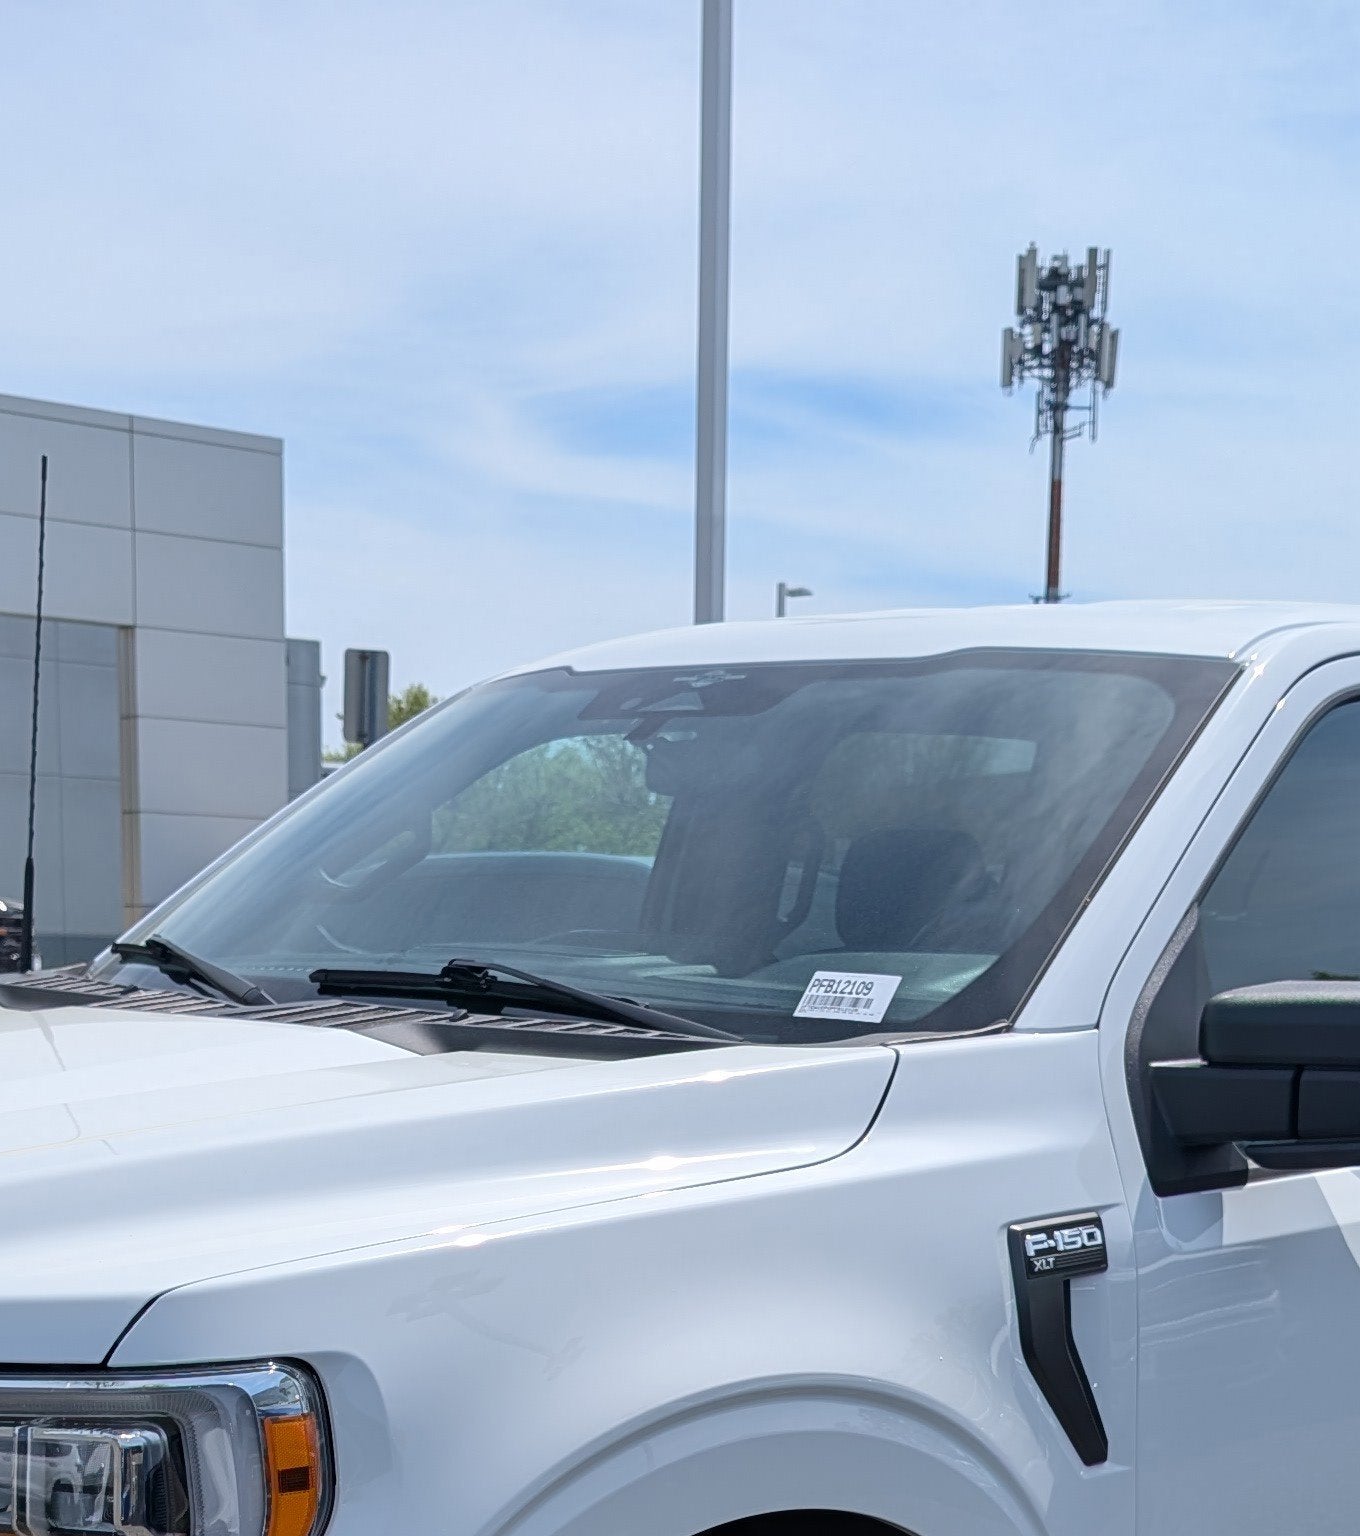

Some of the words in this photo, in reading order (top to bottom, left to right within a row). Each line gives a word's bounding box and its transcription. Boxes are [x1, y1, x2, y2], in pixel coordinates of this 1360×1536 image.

[810, 978, 874, 997] PFB12109
[1025, 1225, 1103, 1257] F-150
[1032, 1257, 1056, 1273] XLT
